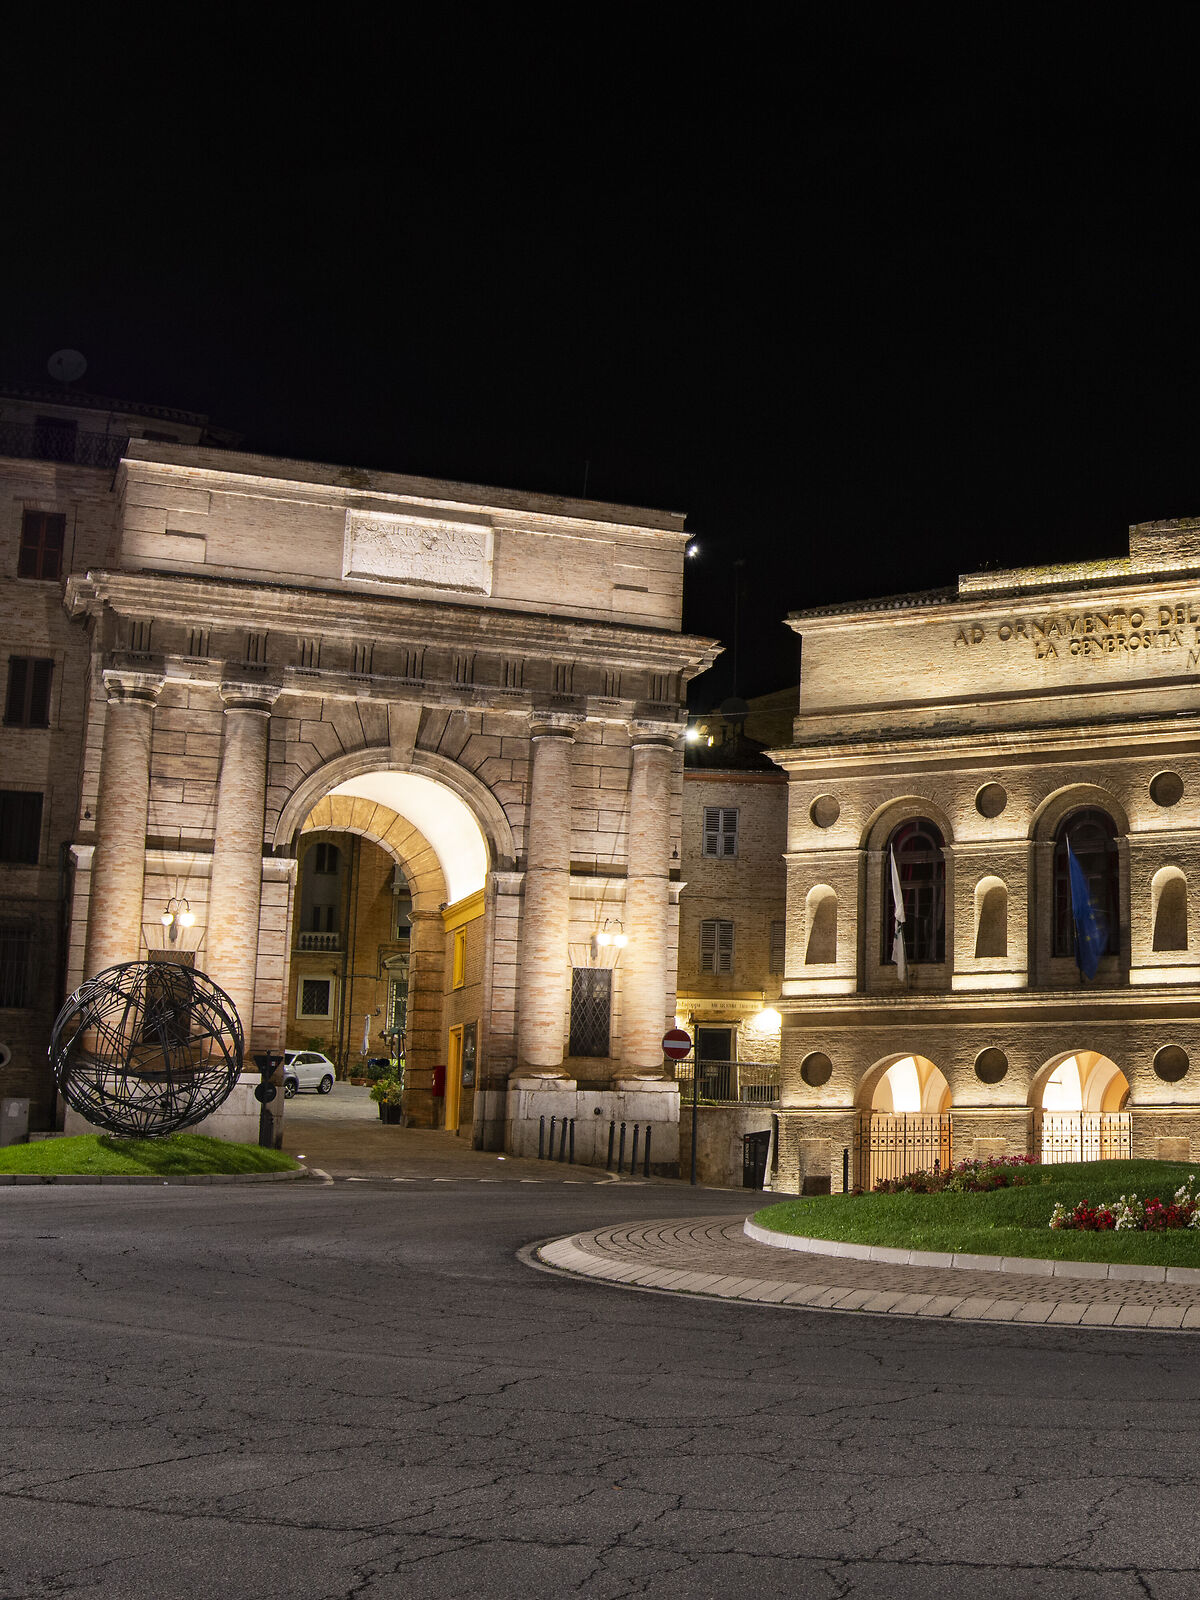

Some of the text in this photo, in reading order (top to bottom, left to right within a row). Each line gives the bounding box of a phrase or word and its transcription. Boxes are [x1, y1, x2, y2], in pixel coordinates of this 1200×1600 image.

[954, 625, 985, 647] AD
[998, 609, 1145, 641] ORNAMENTO
[1035, 642, 1059, 660] LA
